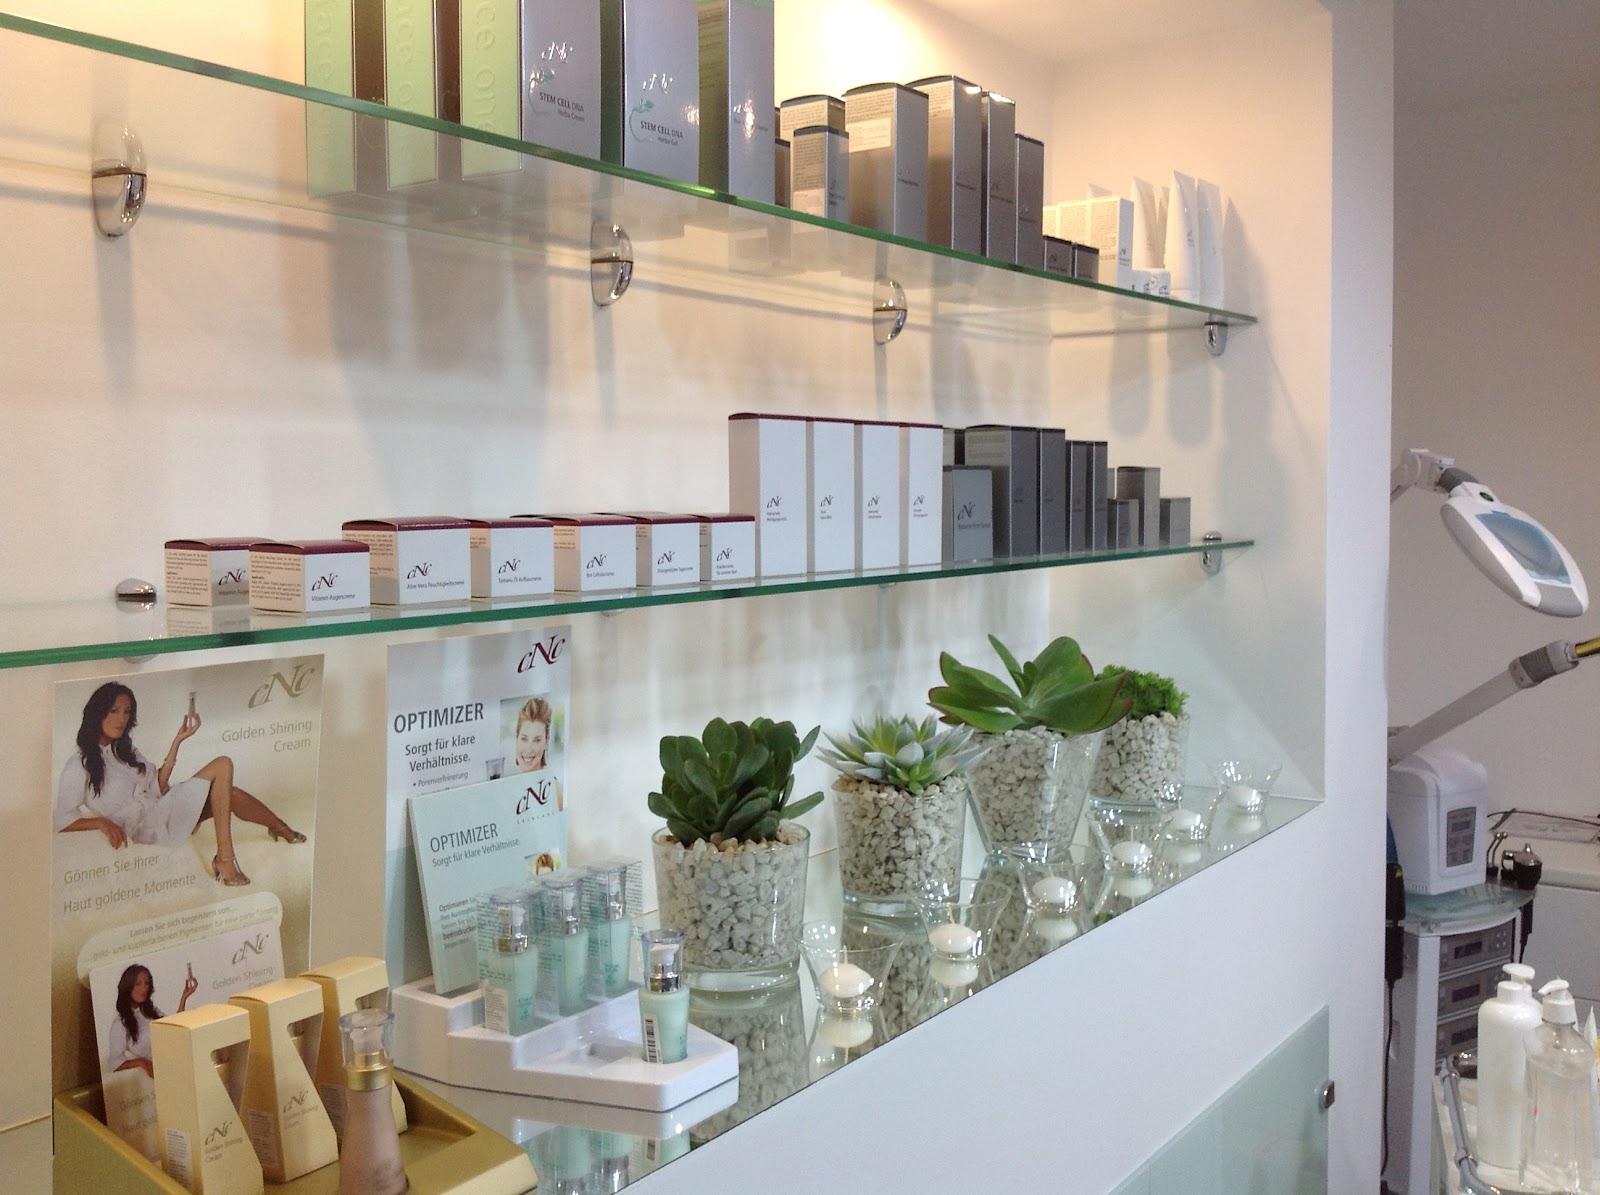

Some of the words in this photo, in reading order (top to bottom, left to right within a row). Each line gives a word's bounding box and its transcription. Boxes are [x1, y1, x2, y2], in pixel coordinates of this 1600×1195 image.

[540, 92, 555, 104] STEM
[557, 98, 571, 109] CELL
[571, 101, 584, 112] DNA
[641, 120, 656, 132] STEM
[657, 125, 671, 136] CELL
[671, 129, 684, 139] DNA
[329, 593, 356, 602] Augencreme
[393, 702, 484, 734] OPTIMIZER
[222, 724, 265, 743] Golden
[269, 719, 312, 737] Shining
[273, 736, 311, 753] Cream
[405, 741, 432, 757] Sorgt
[435, 739, 449, 751] für
[451, 734, 476, 748] klare
[409, 752, 471, 773] Verhältnisse.
[417, 771, 469, 787] Porenverfeinerung
[430, 823, 499, 853] OPTIMIZER
[432, 855, 452, 868] Sorgt
[453, 852, 463, 862] für
[464, 846, 481, 858] klare
[63, 862, 110, 885] Gönnen
[114, 859, 131, 874] Sie
[133, 854, 159, 869] Ihrer
[63, 897, 93, 914] Haut
[95, 886, 141, 911] goldene
[144, 873, 197, 895] Momente
[155, 921, 166, 931] Sie
[166, 917, 181, 929] sich
[181, 911, 217, 926] begeistern
[212, 975, 241, 990] Golden
[243, 966, 274, 979] Shining
